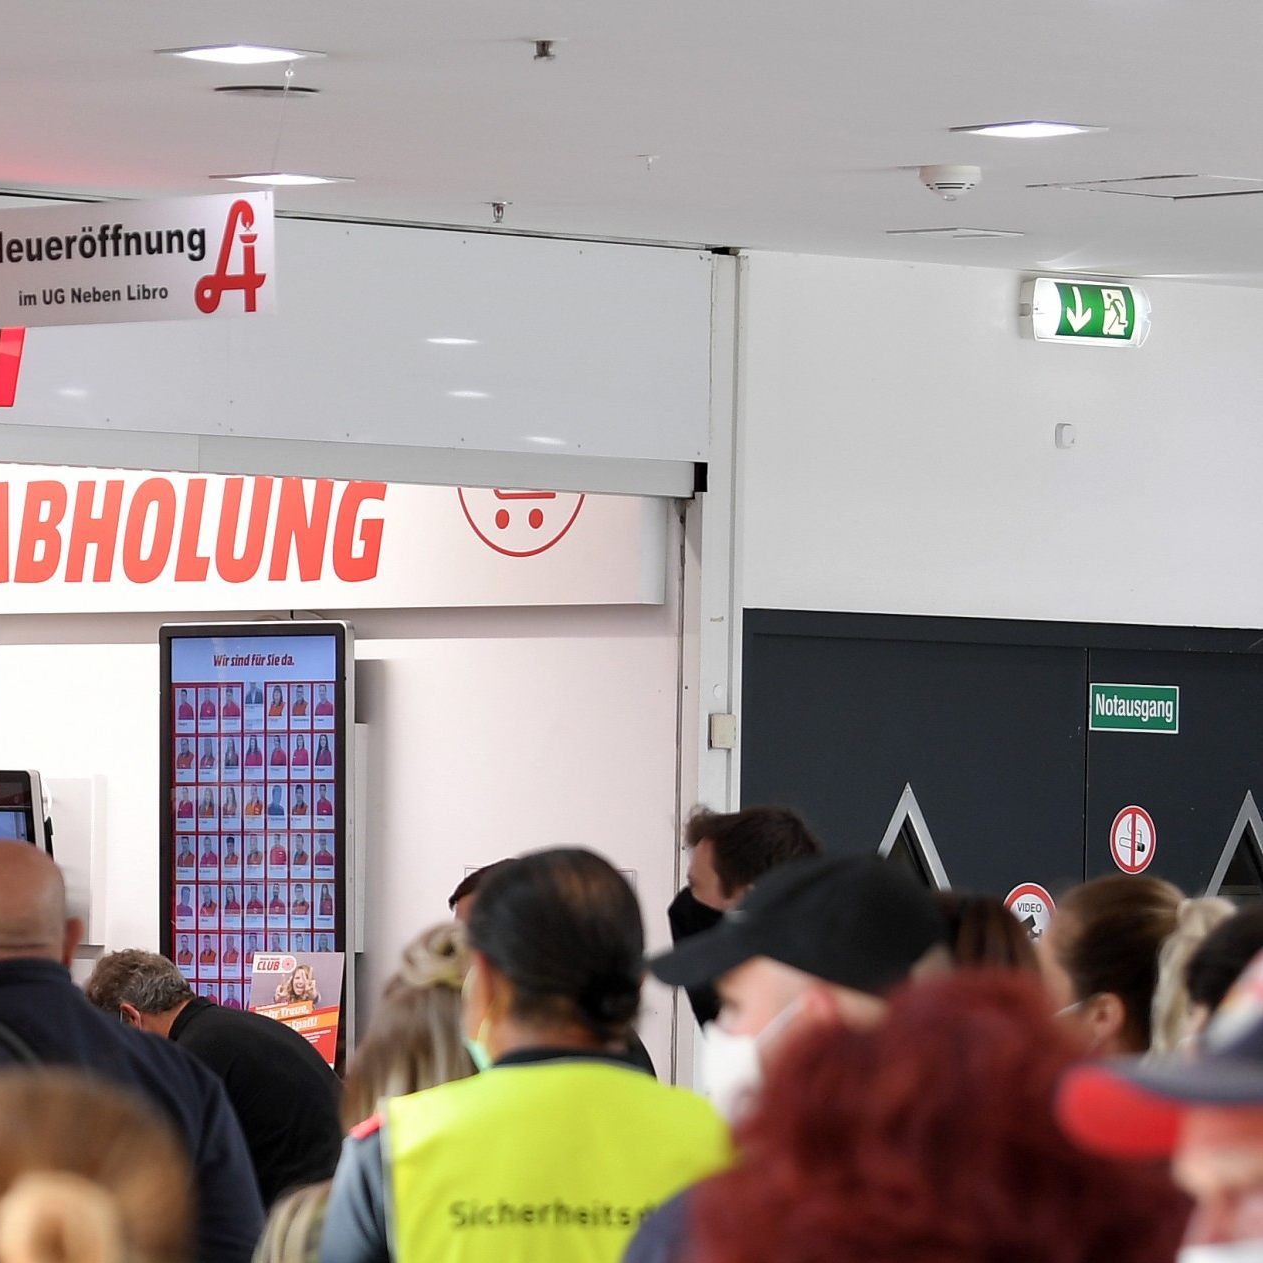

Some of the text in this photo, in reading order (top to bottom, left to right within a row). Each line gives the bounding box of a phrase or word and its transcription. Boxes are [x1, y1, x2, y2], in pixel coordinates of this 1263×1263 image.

[18, 283, 169, 306] im UG Neben Libro
[213, 653, 295, 667] Wir sind für Sie da.
[1095, 693, 1174, 723] Notausgang
[1016, 902, 1042, 913] VIDEO
[256, 961, 280, 971] CLUB
